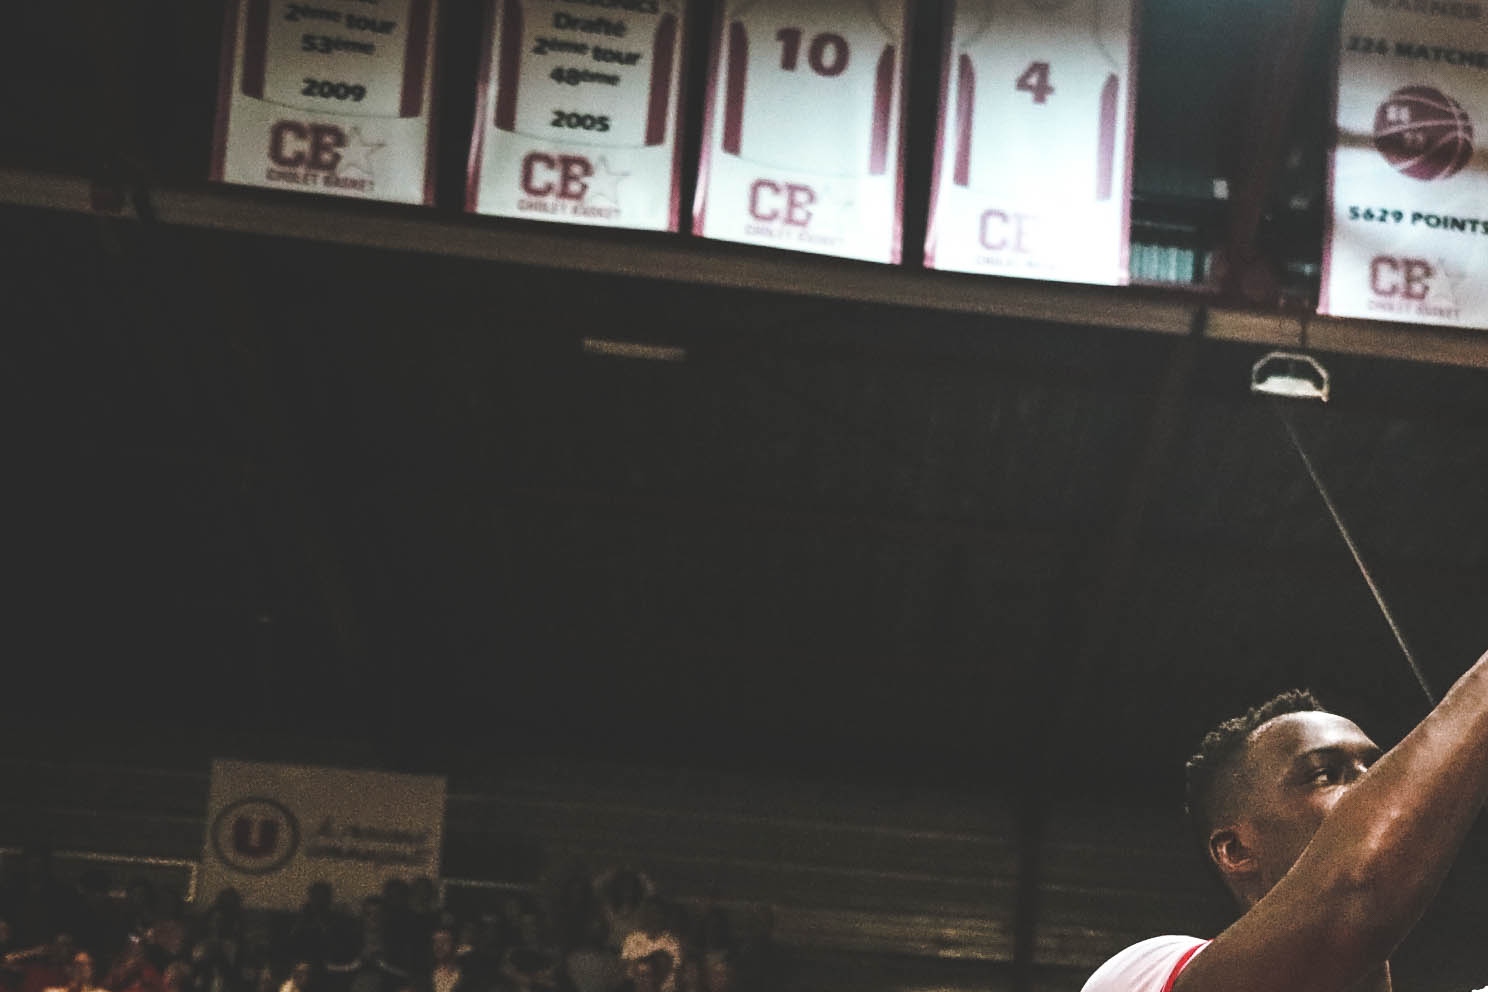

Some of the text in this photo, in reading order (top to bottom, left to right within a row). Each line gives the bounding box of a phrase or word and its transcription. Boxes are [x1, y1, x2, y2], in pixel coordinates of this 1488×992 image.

[775, 27, 850, 78] 10
[302, 79, 367, 103] 2009
[1015, 60, 1056, 105] 4
[550, 109, 612, 133] 2005
[269, 120, 346, 170] CB
[520, 151, 594, 200] CB
[747, 178, 817, 227] CB
[1348, 206, 1405, 224] 5629
[1369, 255, 1434, 301] CB
